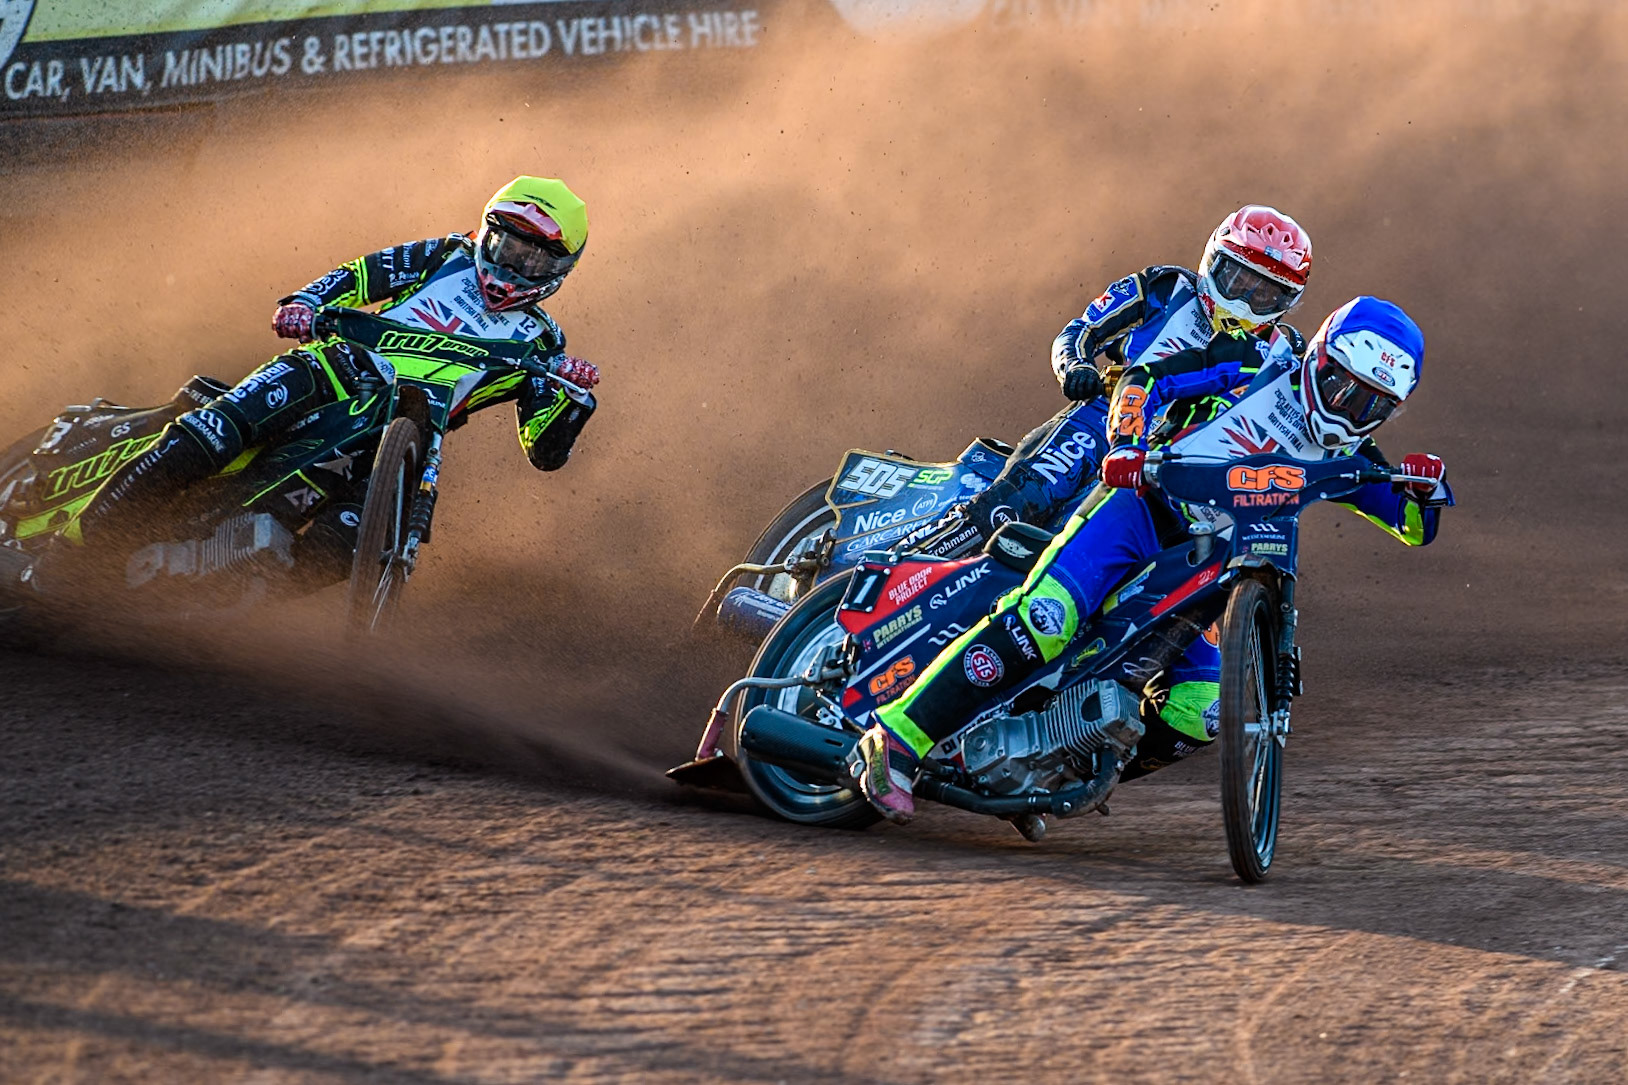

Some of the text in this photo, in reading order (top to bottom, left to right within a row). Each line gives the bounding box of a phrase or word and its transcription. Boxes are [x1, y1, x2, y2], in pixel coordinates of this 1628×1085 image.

[4, 11, 760, 101] CAR, VAN, MINIBUS & REFRIGERATED VEHICLE HIRE
[453, 295, 477, 319] BRITISH
[473, 310, 490, 332] FINAL
[519, 316, 537, 333] 12
[1190, 328, 1209, 348] BRITIS
[110, 421, 132, 438] GS
[1267, 411, 1291, 438] BRITISH
[1287, 429, 1304, 453] FINAL
[1031, 431, 1097, 485] Nice
[836, 457, 919, 499] 505
[1226, 464, 1307, 492] CFS
[852, 508, 907, 535] Nice
[853, 574, 878, 604] 1
[888, 567, 933, 601] BLUE DOOR
[895, 579, 929, 606] PROJECT
[944, 562, 991, 598] LINK
[872, 604, 924, 643] PARRYS
[1011, 626, 1038, 660] LINK
[868, 654, 916, 696] CFS
